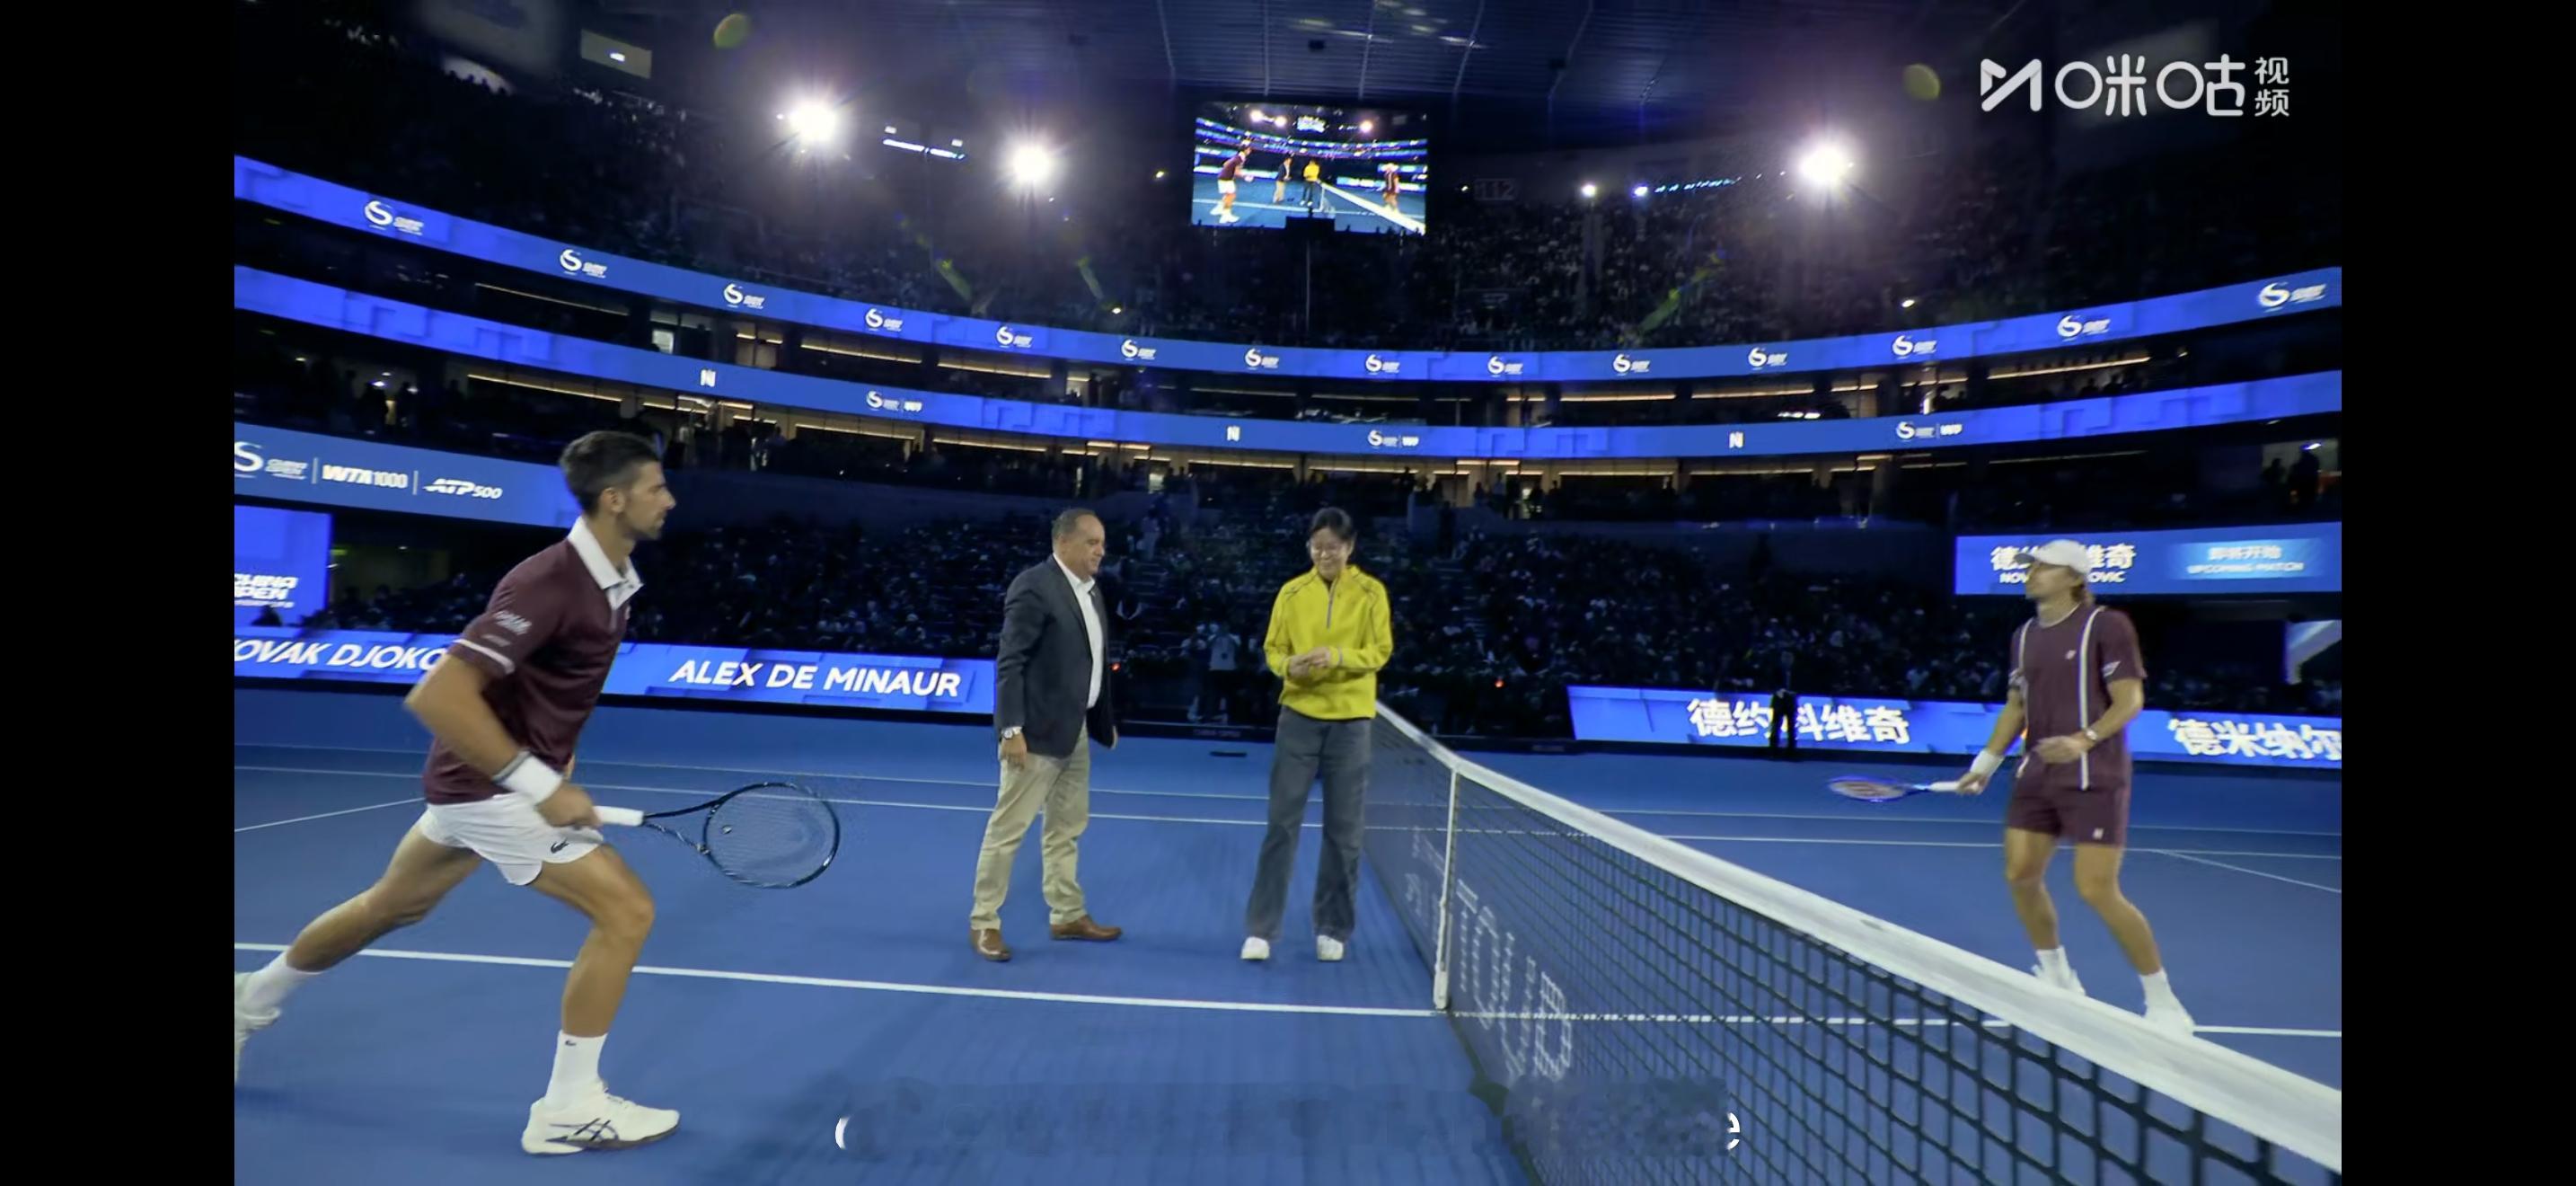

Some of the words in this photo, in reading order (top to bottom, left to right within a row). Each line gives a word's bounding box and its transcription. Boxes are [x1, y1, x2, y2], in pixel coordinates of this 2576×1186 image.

[234, 639, 333, 665] OVAK
[326, 643, 449, 671] DJOKO
[668, 659, 763, 687] ALEX
[765, 664, 817, 690] DE
[822, 667, 961, 697] MINAUR
